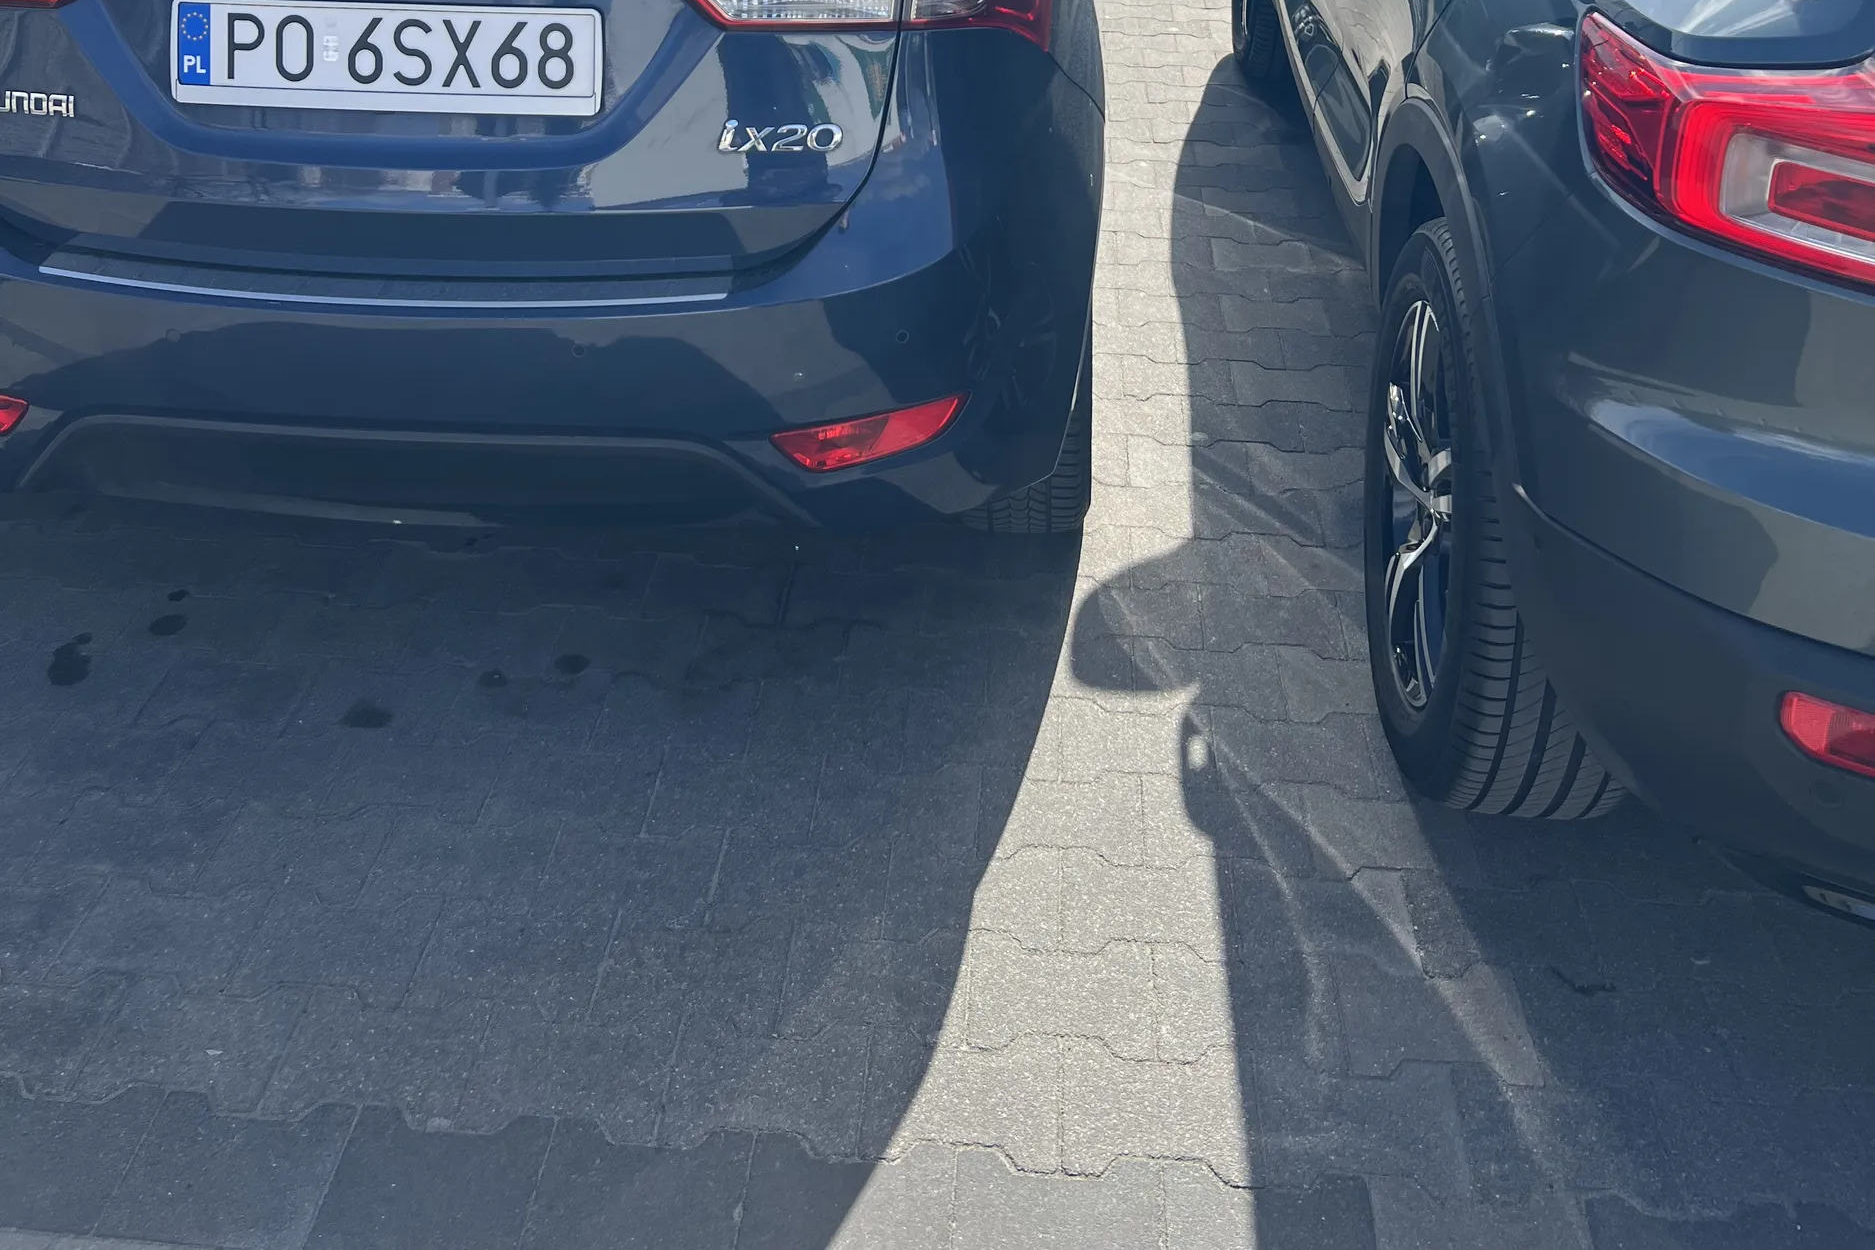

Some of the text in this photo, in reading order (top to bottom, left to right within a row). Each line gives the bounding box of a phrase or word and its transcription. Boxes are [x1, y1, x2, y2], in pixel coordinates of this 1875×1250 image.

[183, 55, 207, 75] PL
[227, 12, 575, 90] PO 6SX68
[718, 119, 844, 152] ix20
